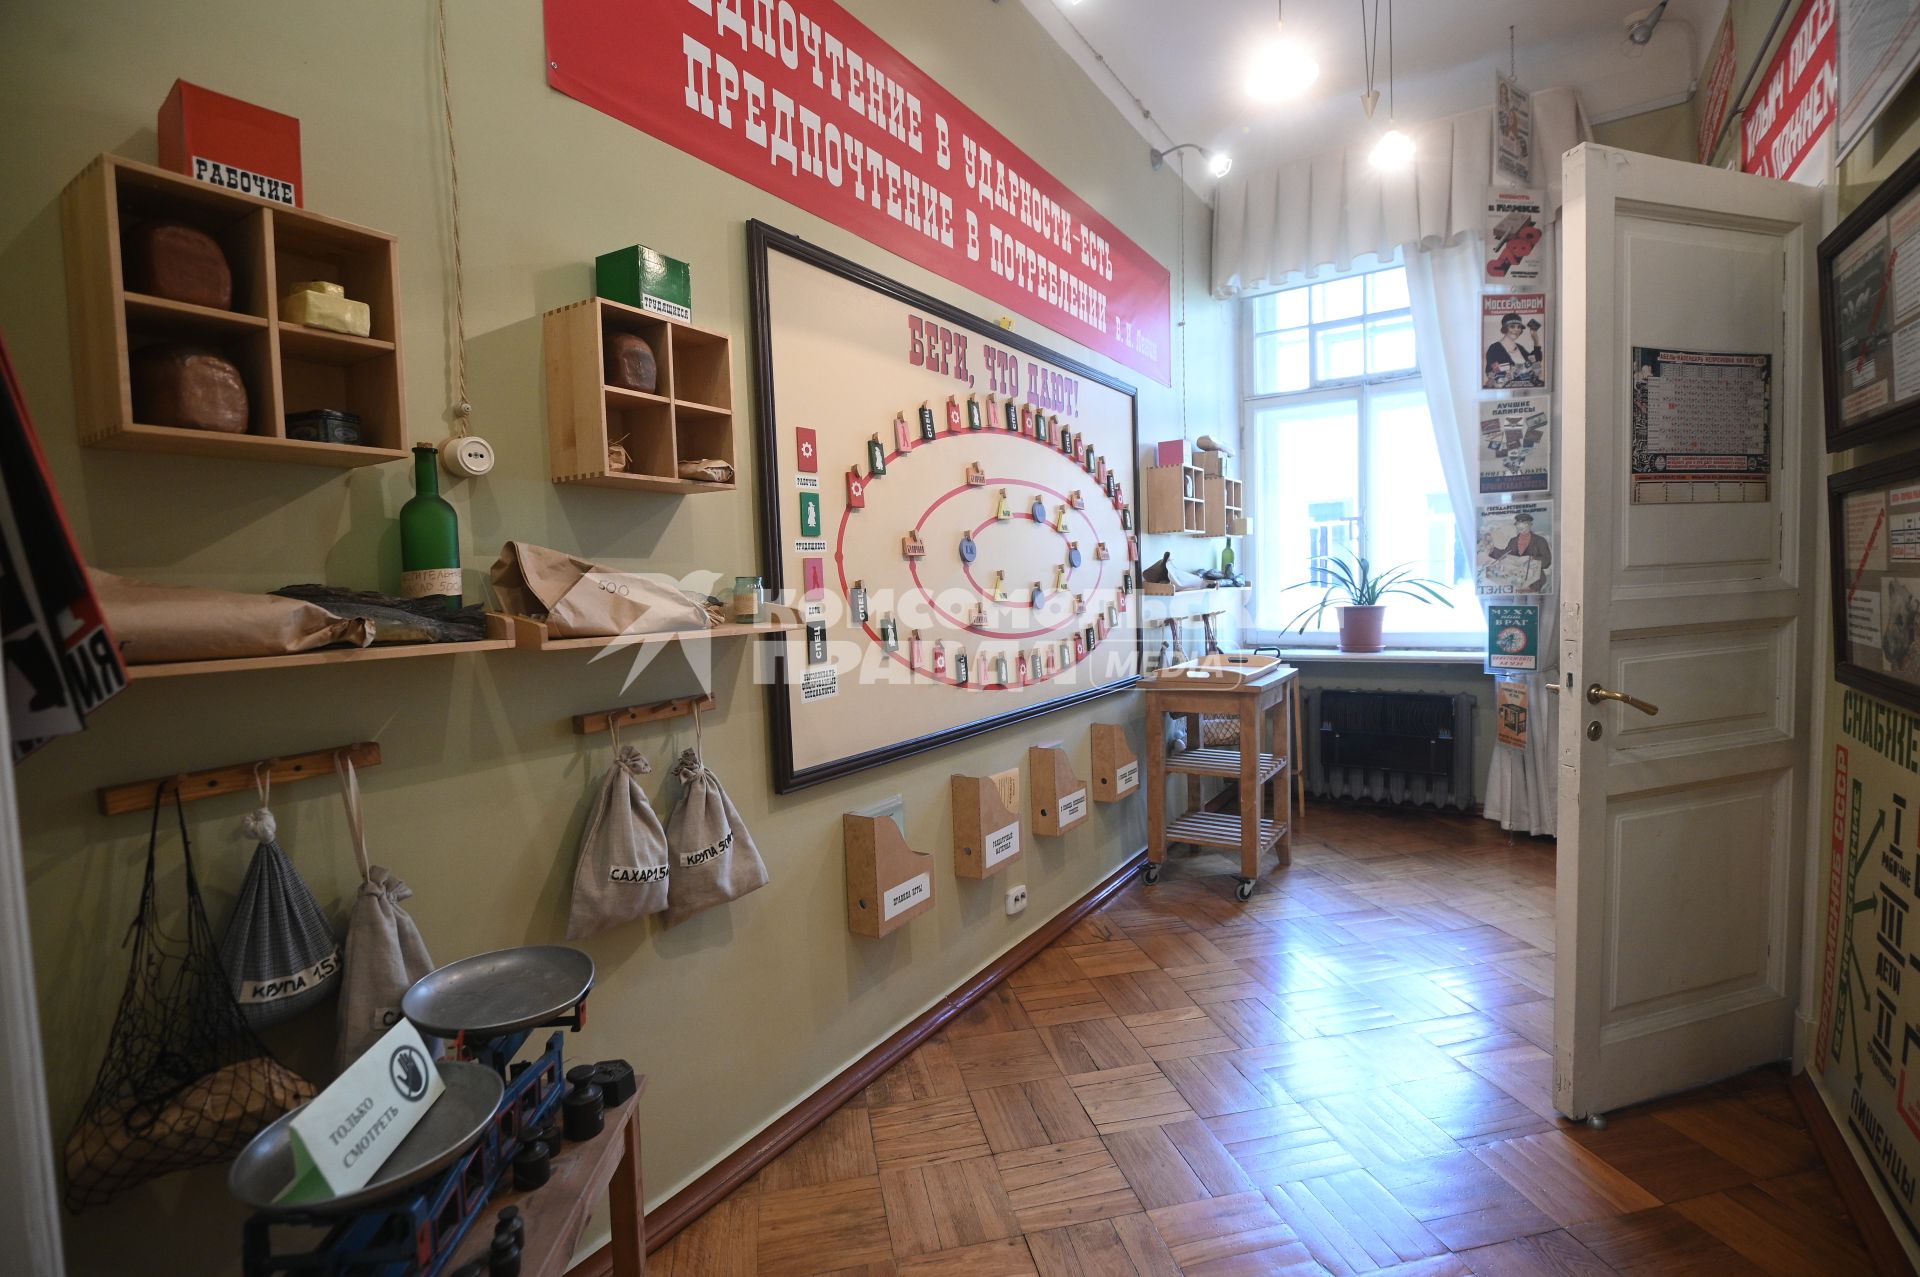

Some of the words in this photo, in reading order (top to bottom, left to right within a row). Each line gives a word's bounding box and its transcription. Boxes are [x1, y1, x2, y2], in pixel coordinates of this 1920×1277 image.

[688, 0, 922, 154] ДПОЧТЕНИЕ
[935, 113, 951, 170] В
[962, 134, 1113, 282] УДАРНОСТИ-ЕСТЬ
[196, 158, 293, 205] РАБОЧИЕ
[683, 33, 954, 249] ПРЕДПОЧТЕНИЕ
[966, 208, 980, 262] В
[990, 223, 1107, 334] ПОТРЕБЛЕНИИ
[644, 296, 689, 319] ТРУДЯЩИЕСЯ
[1485, 296, 1544, 311] МОССЕЛЬПРОМ
[908, 314, 975, 389] БЕРИ,
[983, 344, 1019, 398] ЧТО
[1026, 362, 1079, 418] ДАЮТ!
[925, 410, 933, 438] СПЕЦ
[1009, 406, 1017, 430] СПЕЦ
[599, 579, 630, 597] 500
[857, 588, 866, 620] СПЕЦ
[813, 626, 822, 659] СПЕЦ
[960, 656, 968, 682] СПЕЦ
[1832, 748, 1848, 842] СССР
[687, 845, 717, 865] КРУПА
[1881, 851, 1912, 889] РАБОЧИЕ
[611, 868, 653, 882] САХАР
[252, 976, 306, 998] КРУПА
[1875, 951, 1901, 995] ДЕТИ
[329, 1097, 374, 1146] ТОЛЬКО
[343, 1106, 399, 1168] СМОТРЕТЬ
